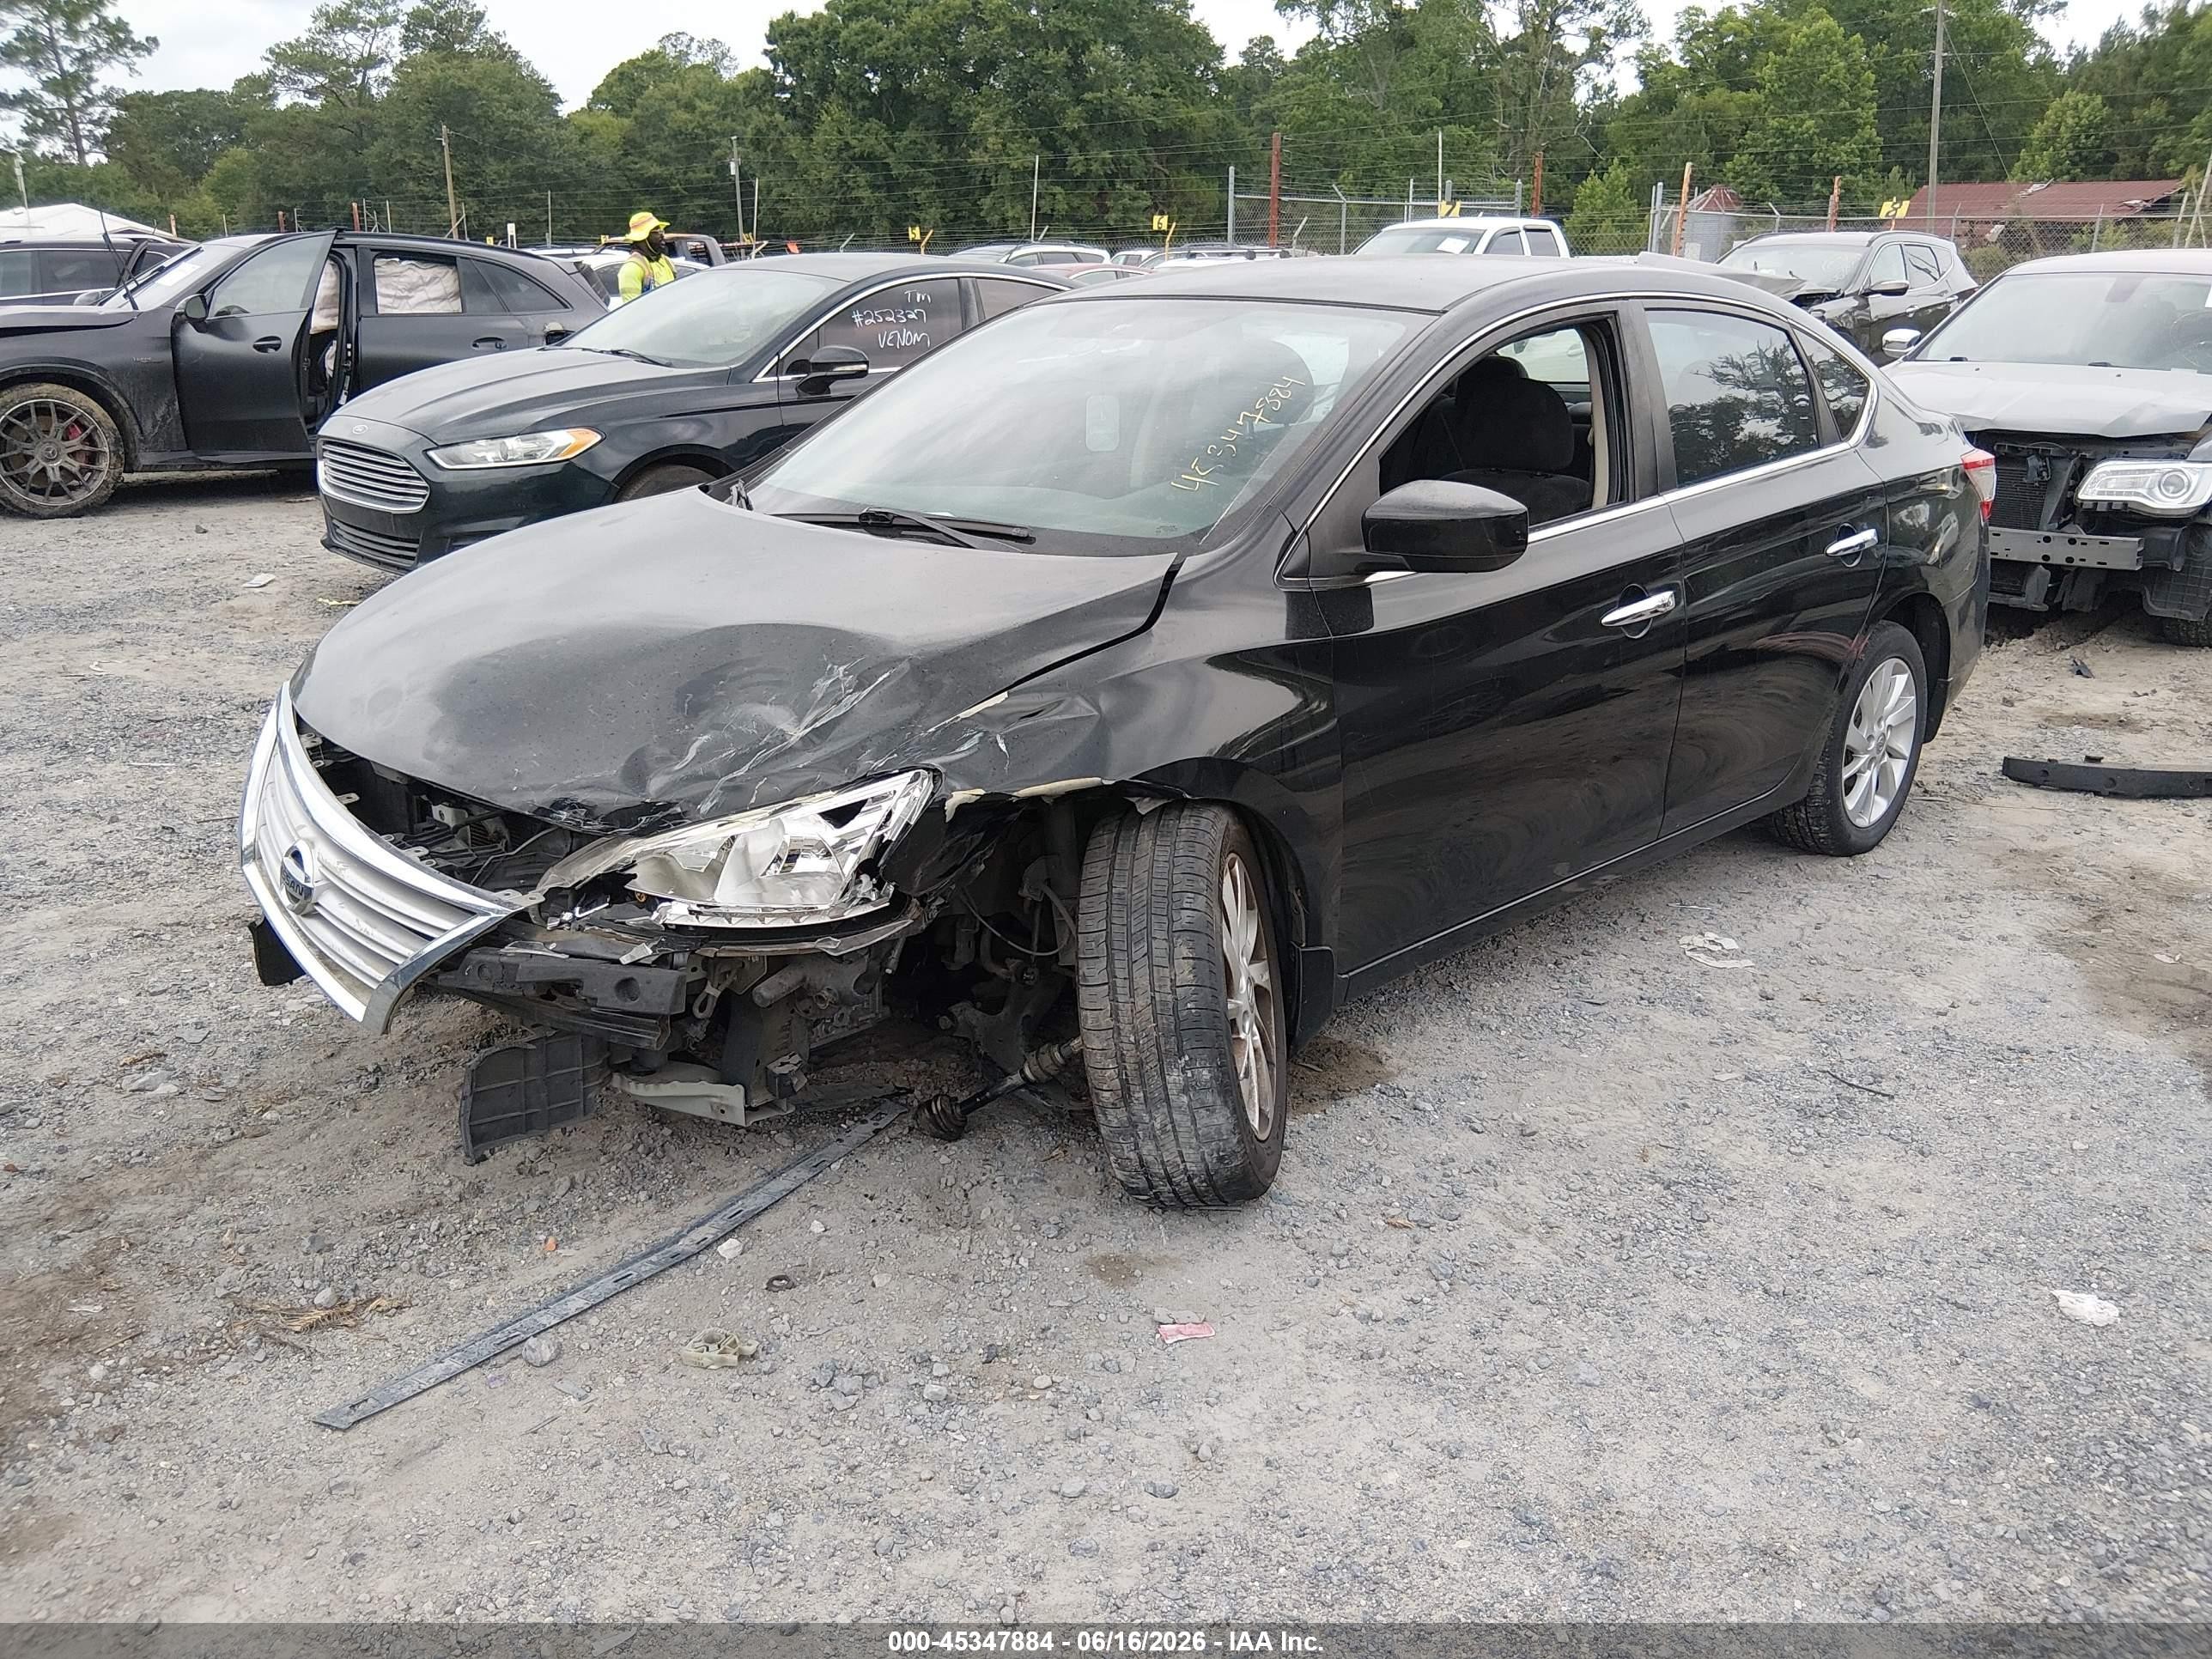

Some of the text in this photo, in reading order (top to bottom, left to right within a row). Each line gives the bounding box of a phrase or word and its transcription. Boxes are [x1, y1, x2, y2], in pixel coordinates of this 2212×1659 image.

[1157, 216, 1164, 229] 6
[910, 227, 917, 240] 5
[852, 309, 926, 327] #252327
[878, 329, 930, 349] VENOM
